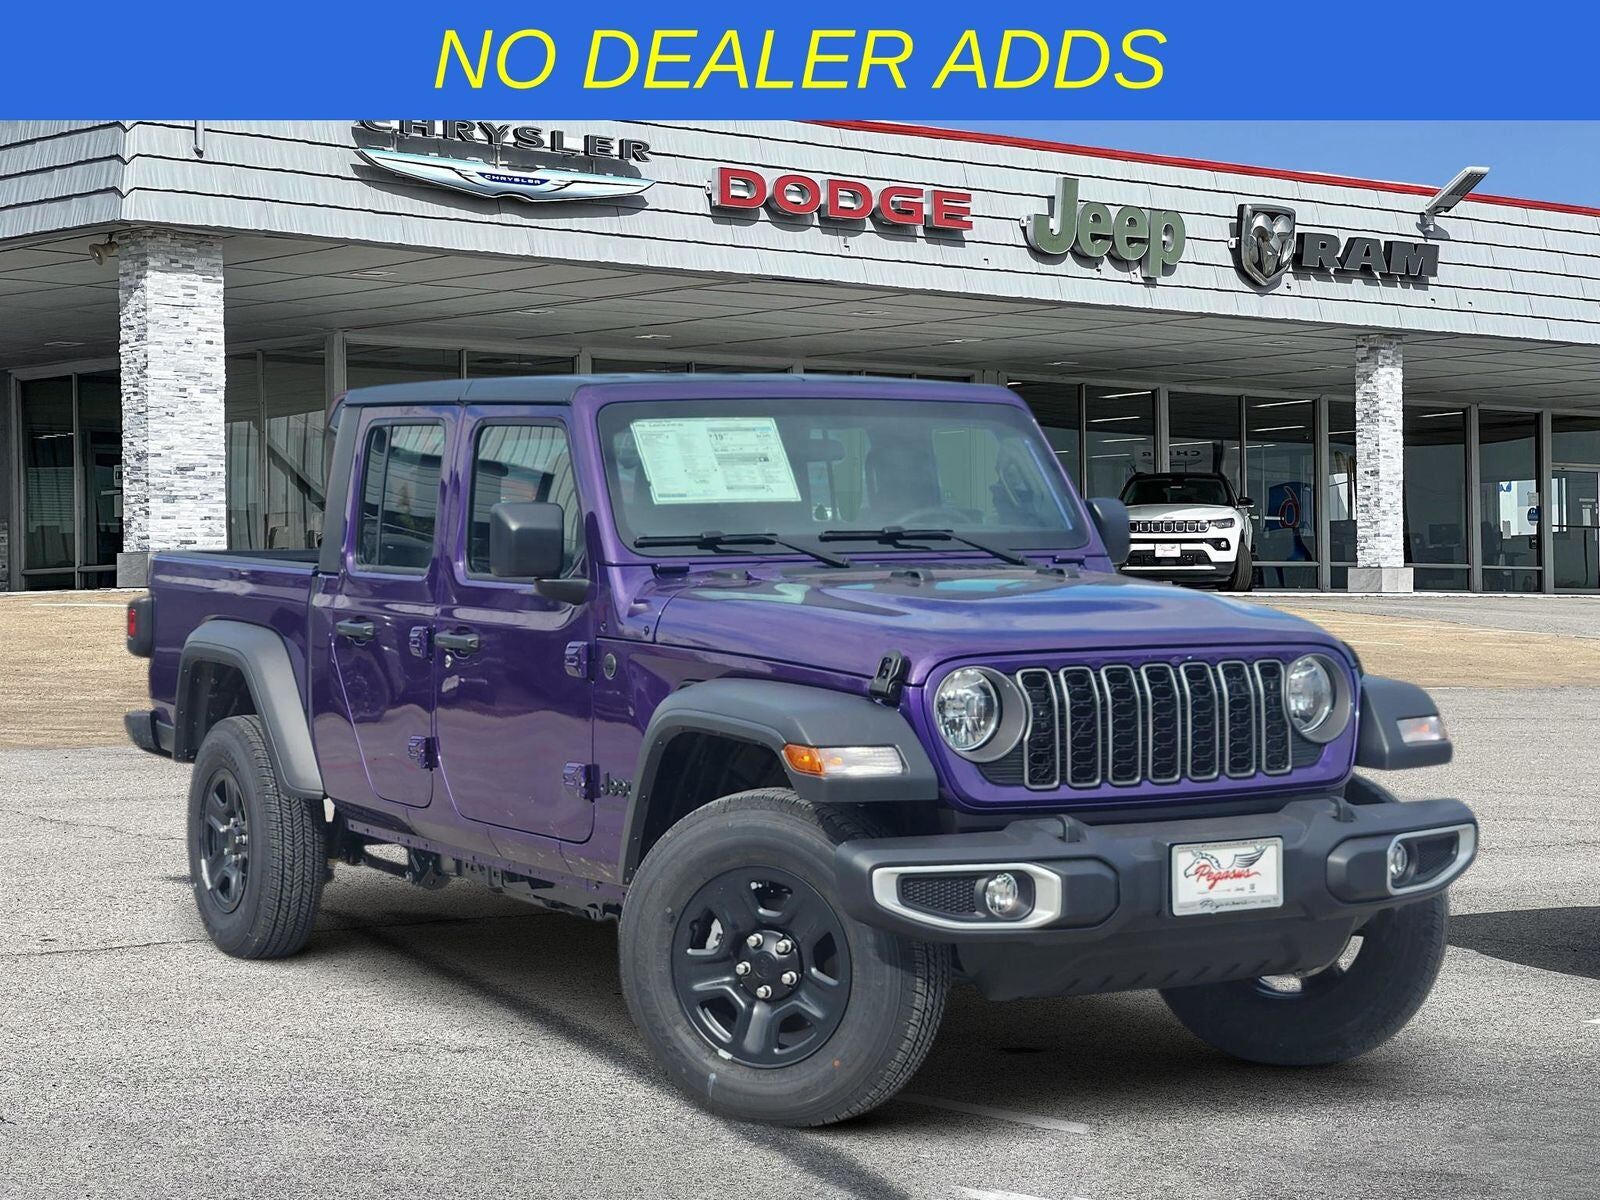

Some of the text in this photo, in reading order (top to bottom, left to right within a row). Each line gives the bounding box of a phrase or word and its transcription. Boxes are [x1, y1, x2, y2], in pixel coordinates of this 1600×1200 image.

[484, 174, 541, 185] CHRYSLER
[713, 166, 973, 230] DODGE
[1027, 177, 1186, 278] Jeep
[1297, 232, 1440, 277] RAM
[1194, 864, 1261, 890] Pegasus
